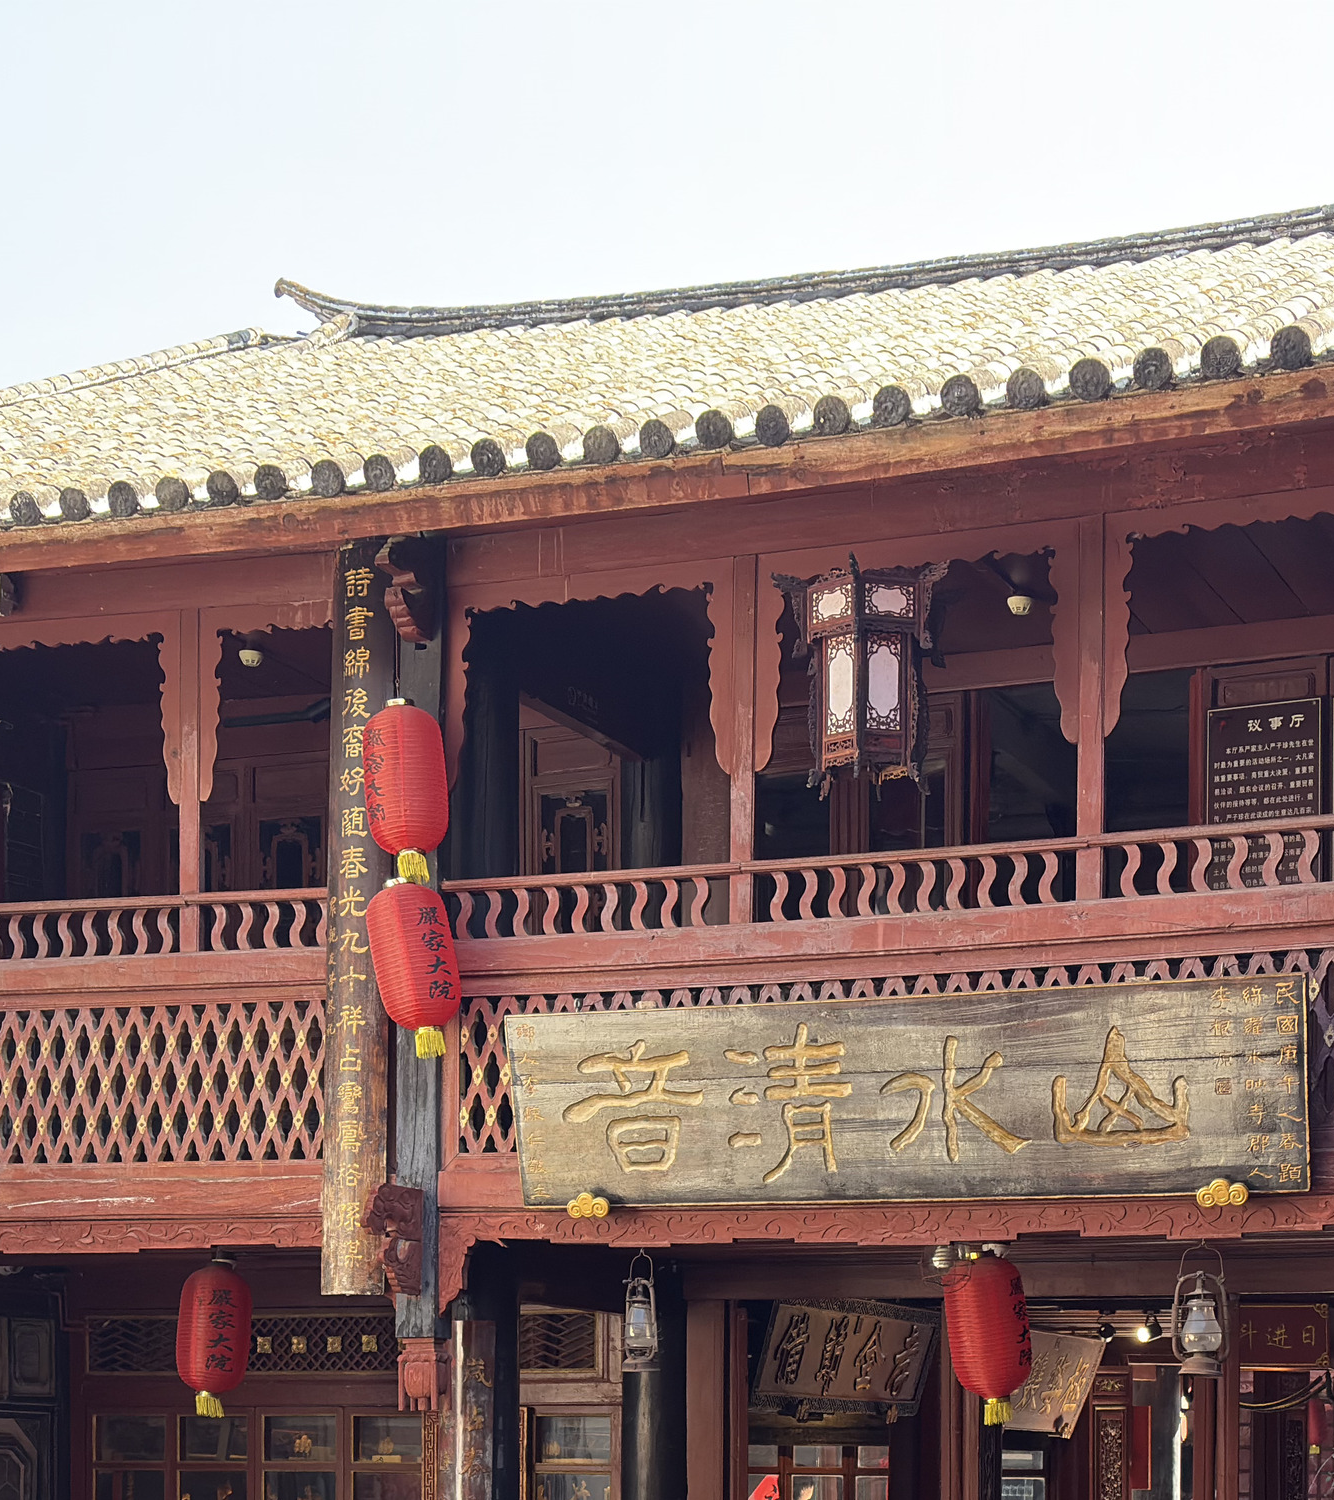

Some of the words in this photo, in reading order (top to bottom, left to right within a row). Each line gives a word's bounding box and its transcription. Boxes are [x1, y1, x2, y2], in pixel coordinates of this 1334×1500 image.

[1247, 714, 1305, 732] 议事厅
[417, 907, 456, 1001] 嚴家大院
[205, 1288, 238, 1374] 嚴家大院
